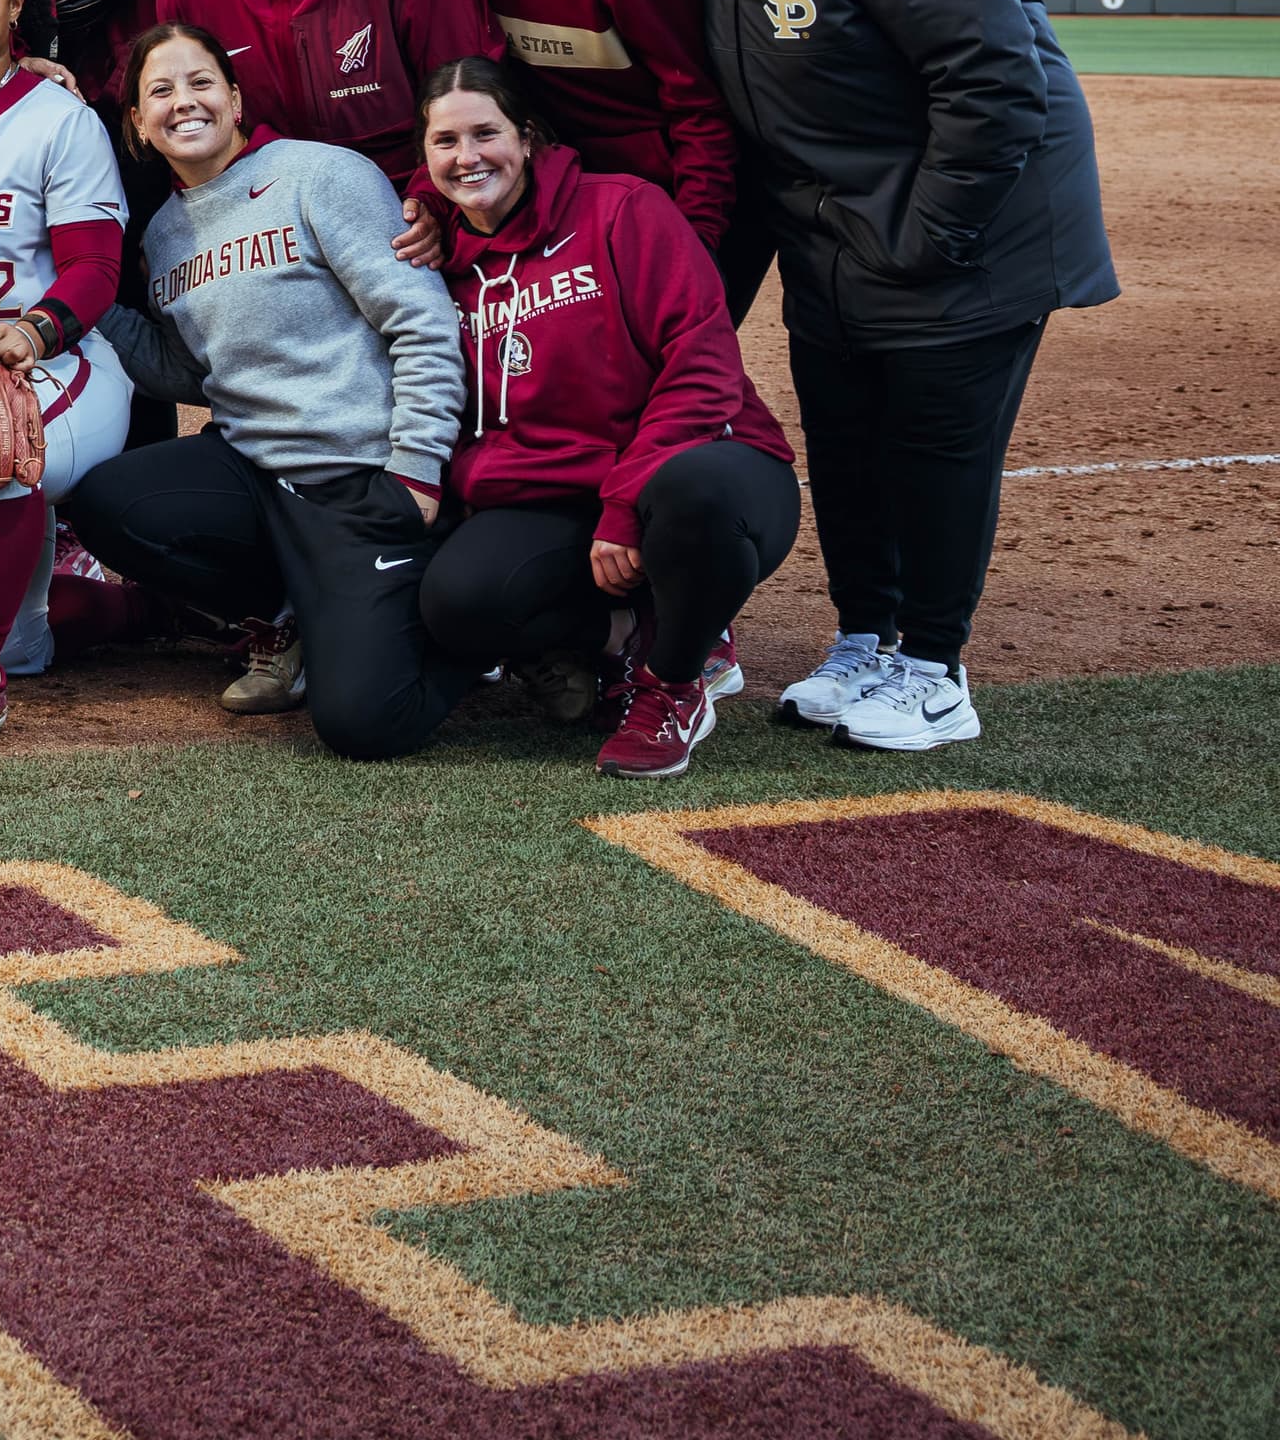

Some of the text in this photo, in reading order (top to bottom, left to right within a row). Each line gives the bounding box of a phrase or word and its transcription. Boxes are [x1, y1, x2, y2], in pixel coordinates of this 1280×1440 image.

[521, 35, 574, 56] STATE
[329, 82, 381, 98] SOFTBALL
[152, 224, 301, 308] FLORIDA STATE
[523, 307, 546, 322] STATE
